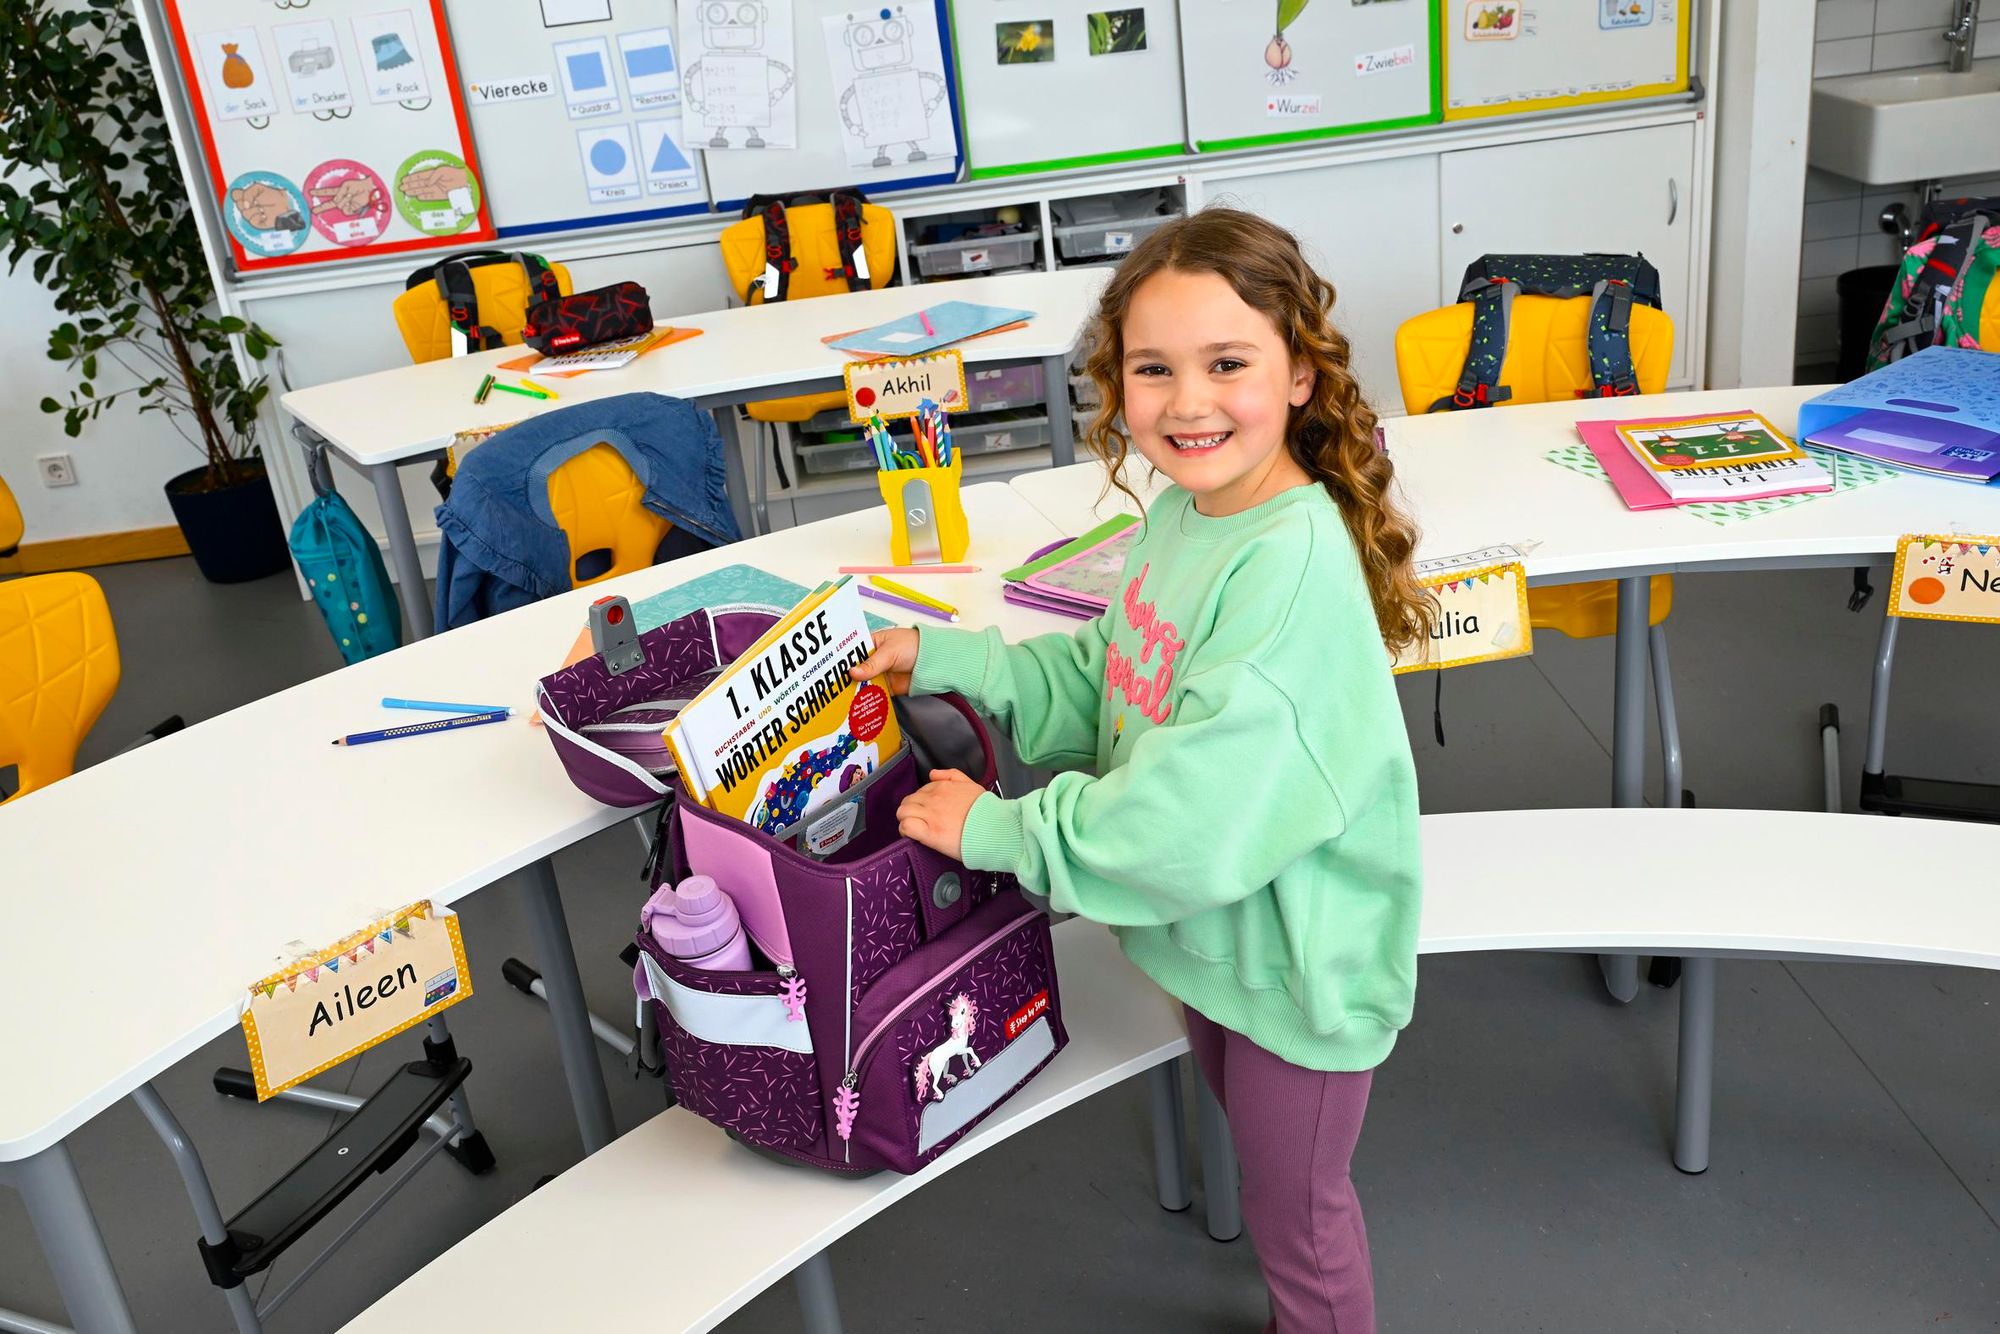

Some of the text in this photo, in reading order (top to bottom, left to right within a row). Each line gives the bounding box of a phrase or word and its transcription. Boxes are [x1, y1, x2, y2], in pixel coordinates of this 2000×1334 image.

[1365, 50, 1413, 72] Zwiebel
[313, 93, 347, 103] Drucker
[397, 84, 419, 93] Rock
[479, 80, 549, 100] Vierecke
[639, 93, 676, 104] Rechteck
[244, 99, 267, 110] Sack
[578, 102, 612, 114] Quadrat
[1277, 99, 1321, 115] Wurzel
[659, 181, 688, 190] Dreieck
[883, 374, 931, 396] Akhil
[1671, 457, 1798, 477] EINMALEINS
[1961, 568, 2000, 593] Ne
[1430, 611, 1479, 640] ulia
[726, 610, 832, 720] 1. KLASSE
[715, 630, 858, 757] BUCHSTABEN UND WÖRTER SCHREIBEN LERNEN
[715, 720, 788, 793] WÖRTER
[309, 962, 417, 1036] Aileen
[1016, 998, 1046, 1028] Step by Step
